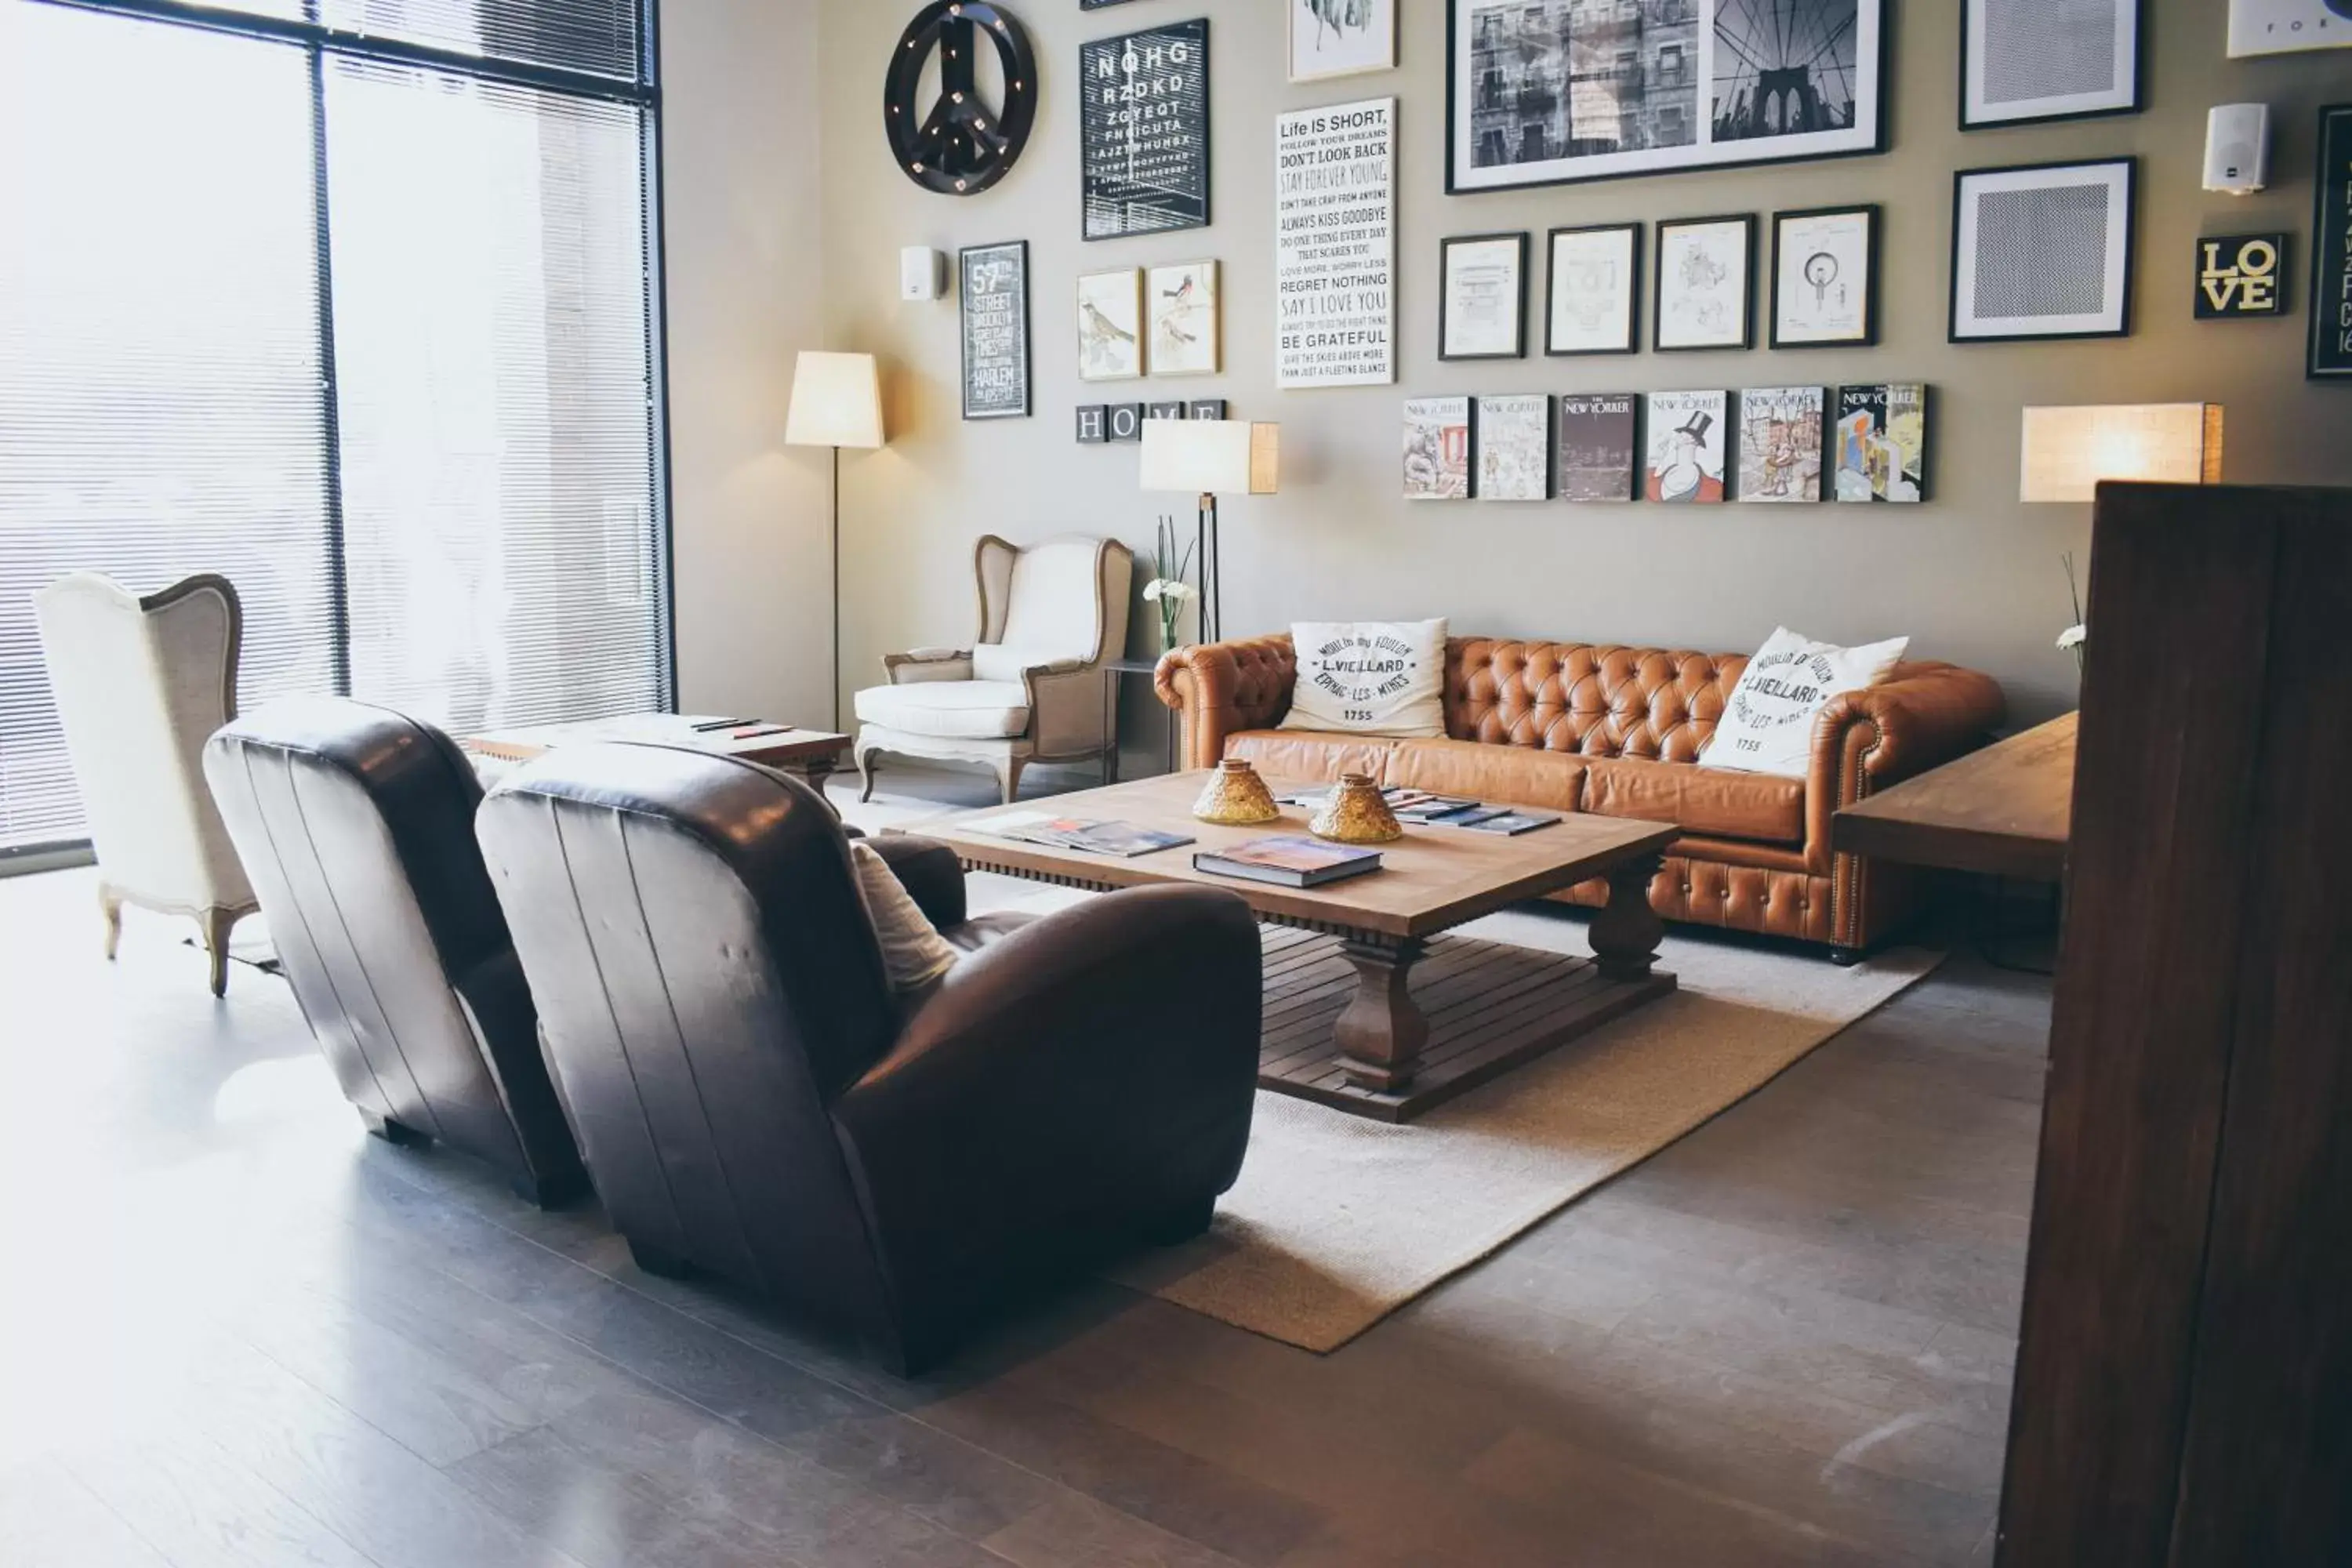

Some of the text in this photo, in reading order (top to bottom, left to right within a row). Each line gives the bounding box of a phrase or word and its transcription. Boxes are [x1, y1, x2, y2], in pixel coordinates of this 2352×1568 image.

[1281, 122, 1307, 138] Life
[1312, 119, 1325, 133] IS
[1281, 129, 1387, 151] FOLLOW YOUR DREAMS
[1281, 142, 1387, 168] DON'T LOOK BACK
[1281, 172, 1302, 194] STAY
[1305, 165, 1346, 190] FOREVER
[1338, 193, 1356, 203] FROM
[1281, 206, 1386, 231] ALWAYS KISS GOODBYE
[1281, 227, 1386, 248] DO ONE THING EVERY DAY
[1298, 249, 1318, 261] THAT
[1320, 245, 1351, 258] SCARES
[1281, 267, 1302, 277] LOVE
[1364, 259, 1386, 268] LESS
[1281, 273, 1386, 293] REGRET NOTHING
[1282, 291, 1386, 317] SAY I LOVE YOU
[1282, 330, 1386, 348] BE GRATEFUL
[1566, 401, 1629, 414] NEW YORKER
[1843, 393, 1870, 405] NEW
[1345, 710, 1373, 720] 1755
[1737, 738, 1762, 752] 1755
